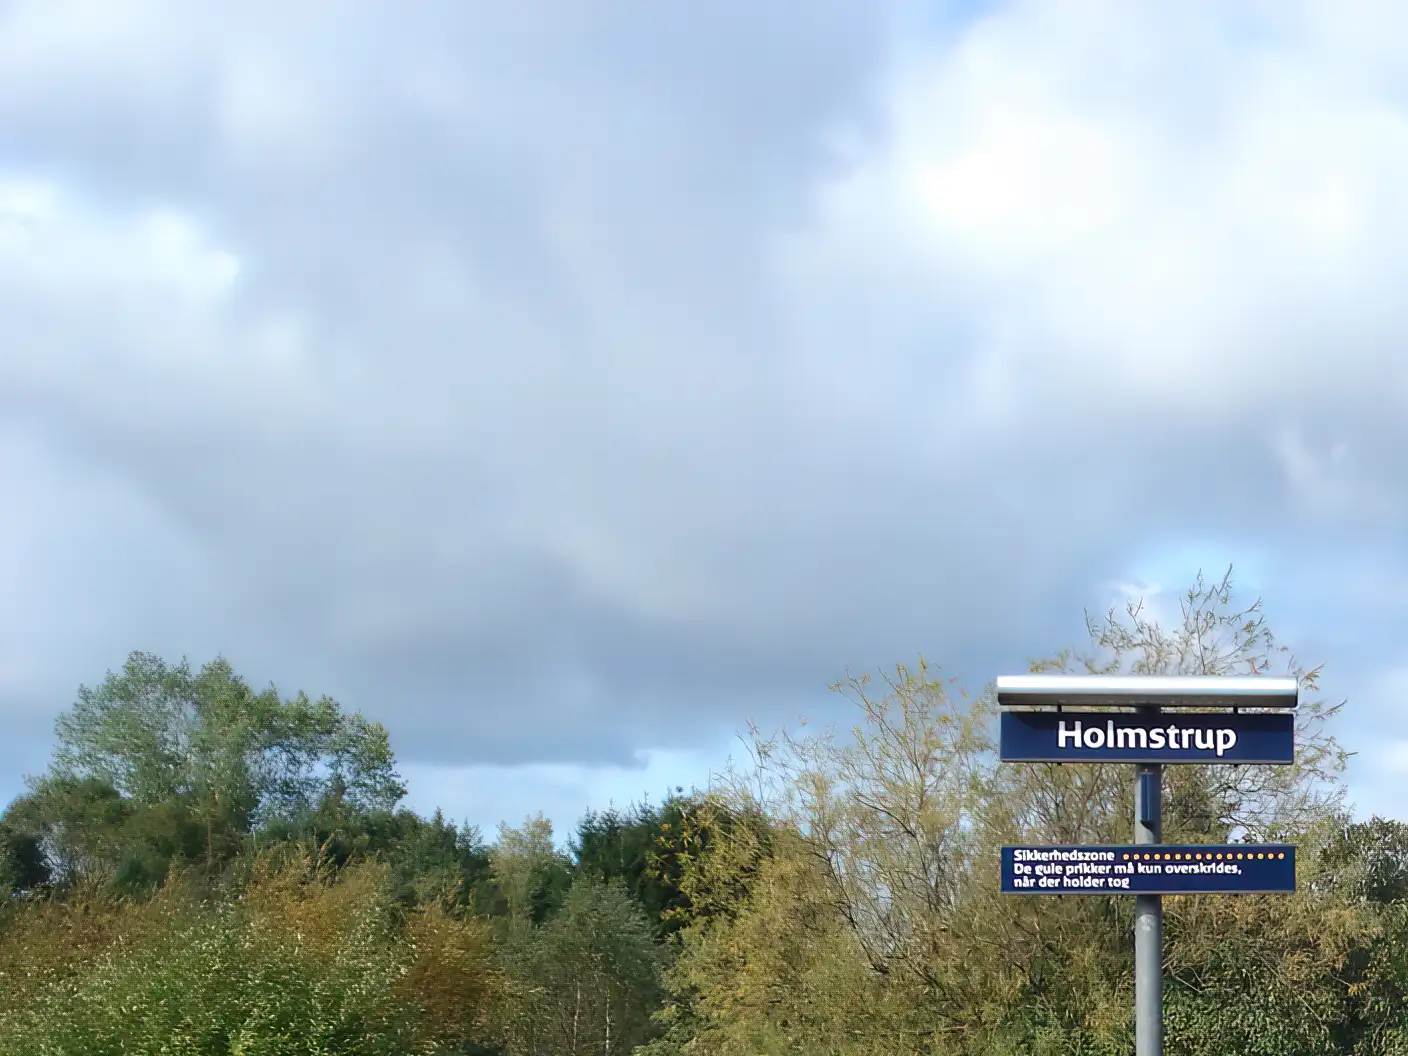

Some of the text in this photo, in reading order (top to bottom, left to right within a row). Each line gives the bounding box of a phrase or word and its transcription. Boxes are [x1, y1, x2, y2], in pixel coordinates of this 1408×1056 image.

[1058, 720, 1237, 756] Holmstrup
[1014, 850, 1114, 861] Sikkerhedszone
[1014, 862, 1242, 877] De gule prikker må kun overskrides,
[1014, 876, 1129, 889] når der holder tog
